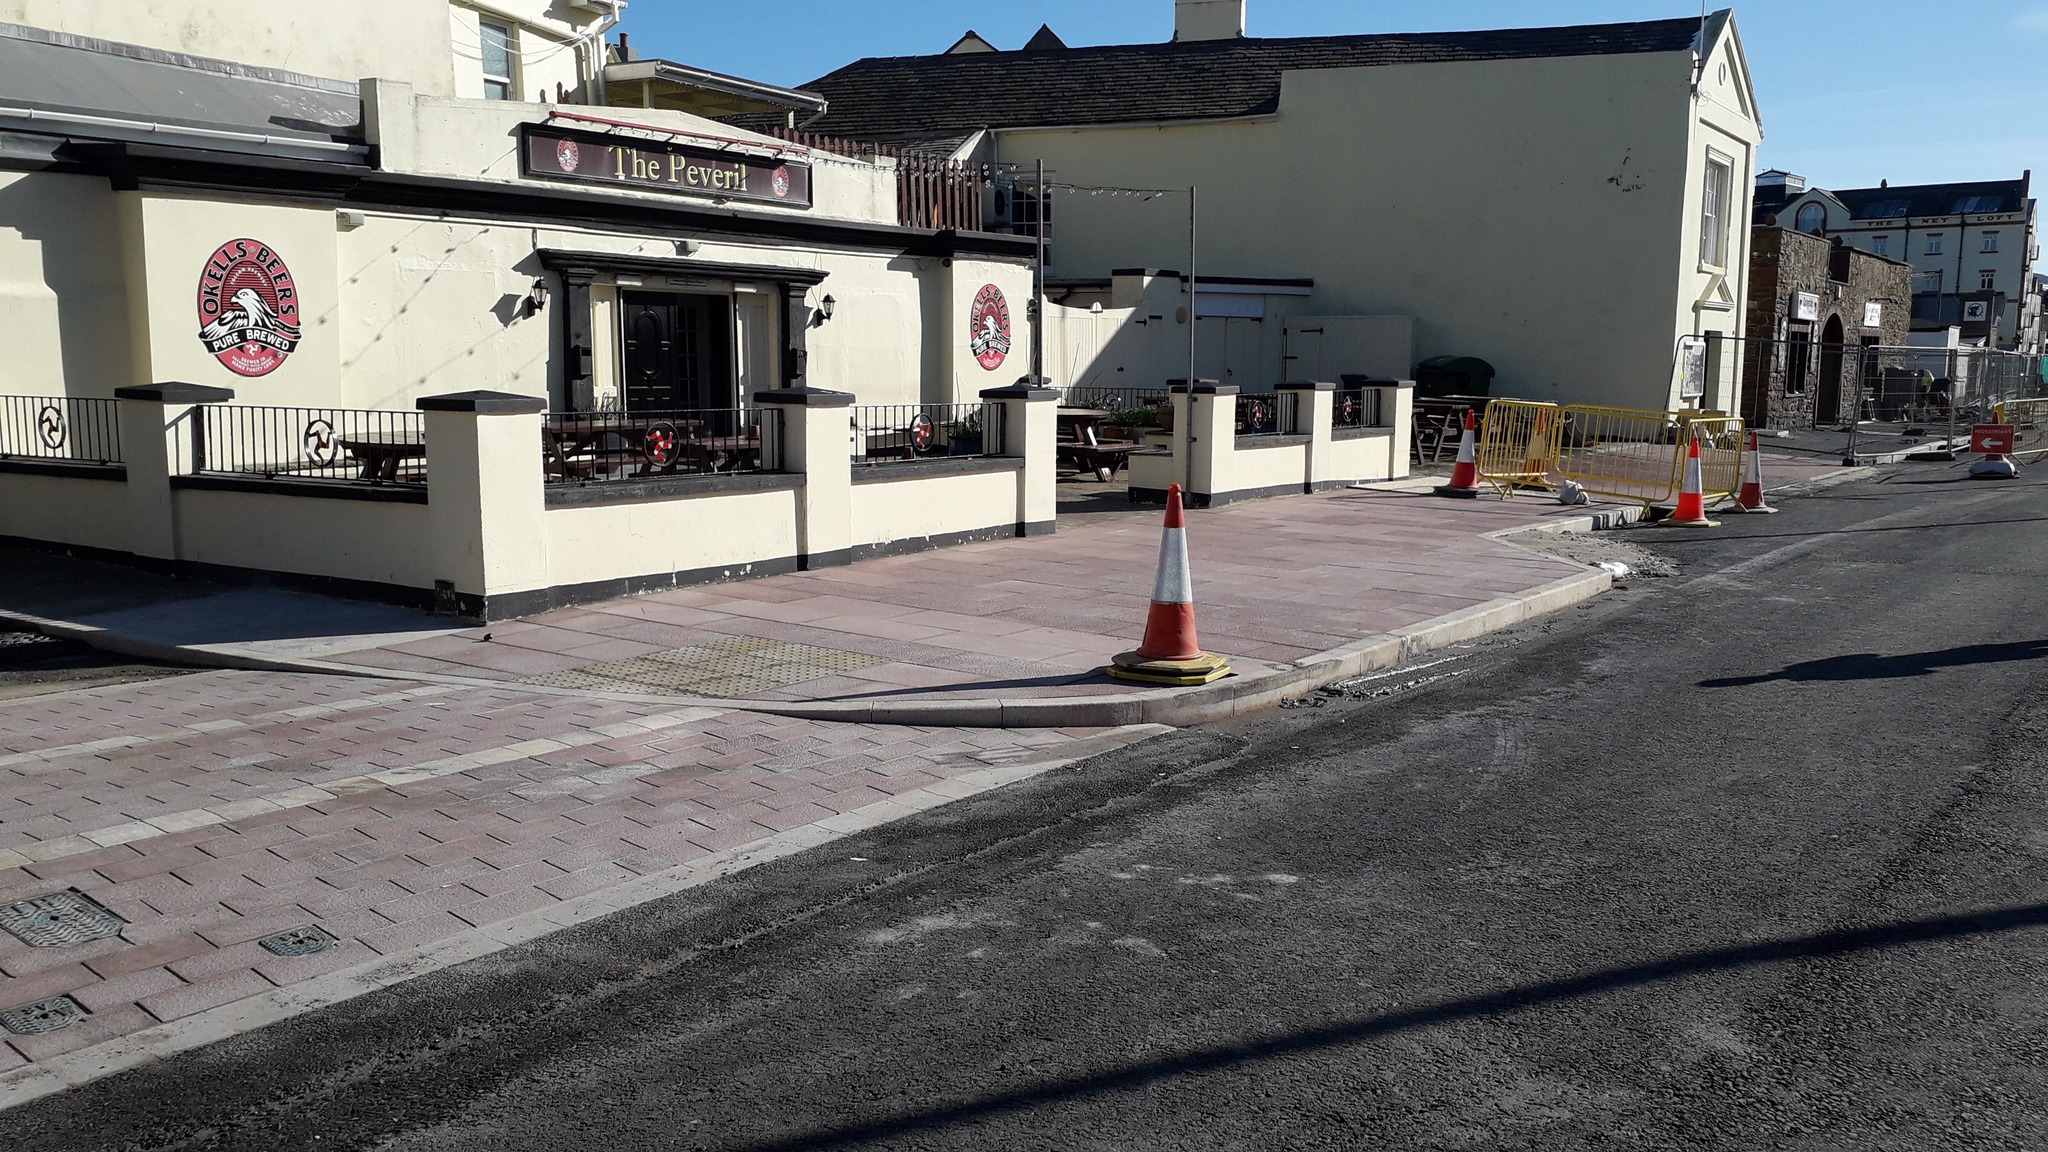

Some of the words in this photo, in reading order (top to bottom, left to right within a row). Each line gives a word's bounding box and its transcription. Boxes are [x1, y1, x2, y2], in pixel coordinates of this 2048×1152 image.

[608, 144, 660, 180] The
[667, 153, 748, 191] Peveril
[1976, 214, 2014, 222] LOFT
[203, 241, 248, 315] OKELLS
[254, 246, 296, 315] BEERS
[972, 286, 991, 333] OKELLS
[993, 289, 1008, 331] BEERS
[212, 333, 241, 351] PURE
[246, 329, 290, 350] BREWED
